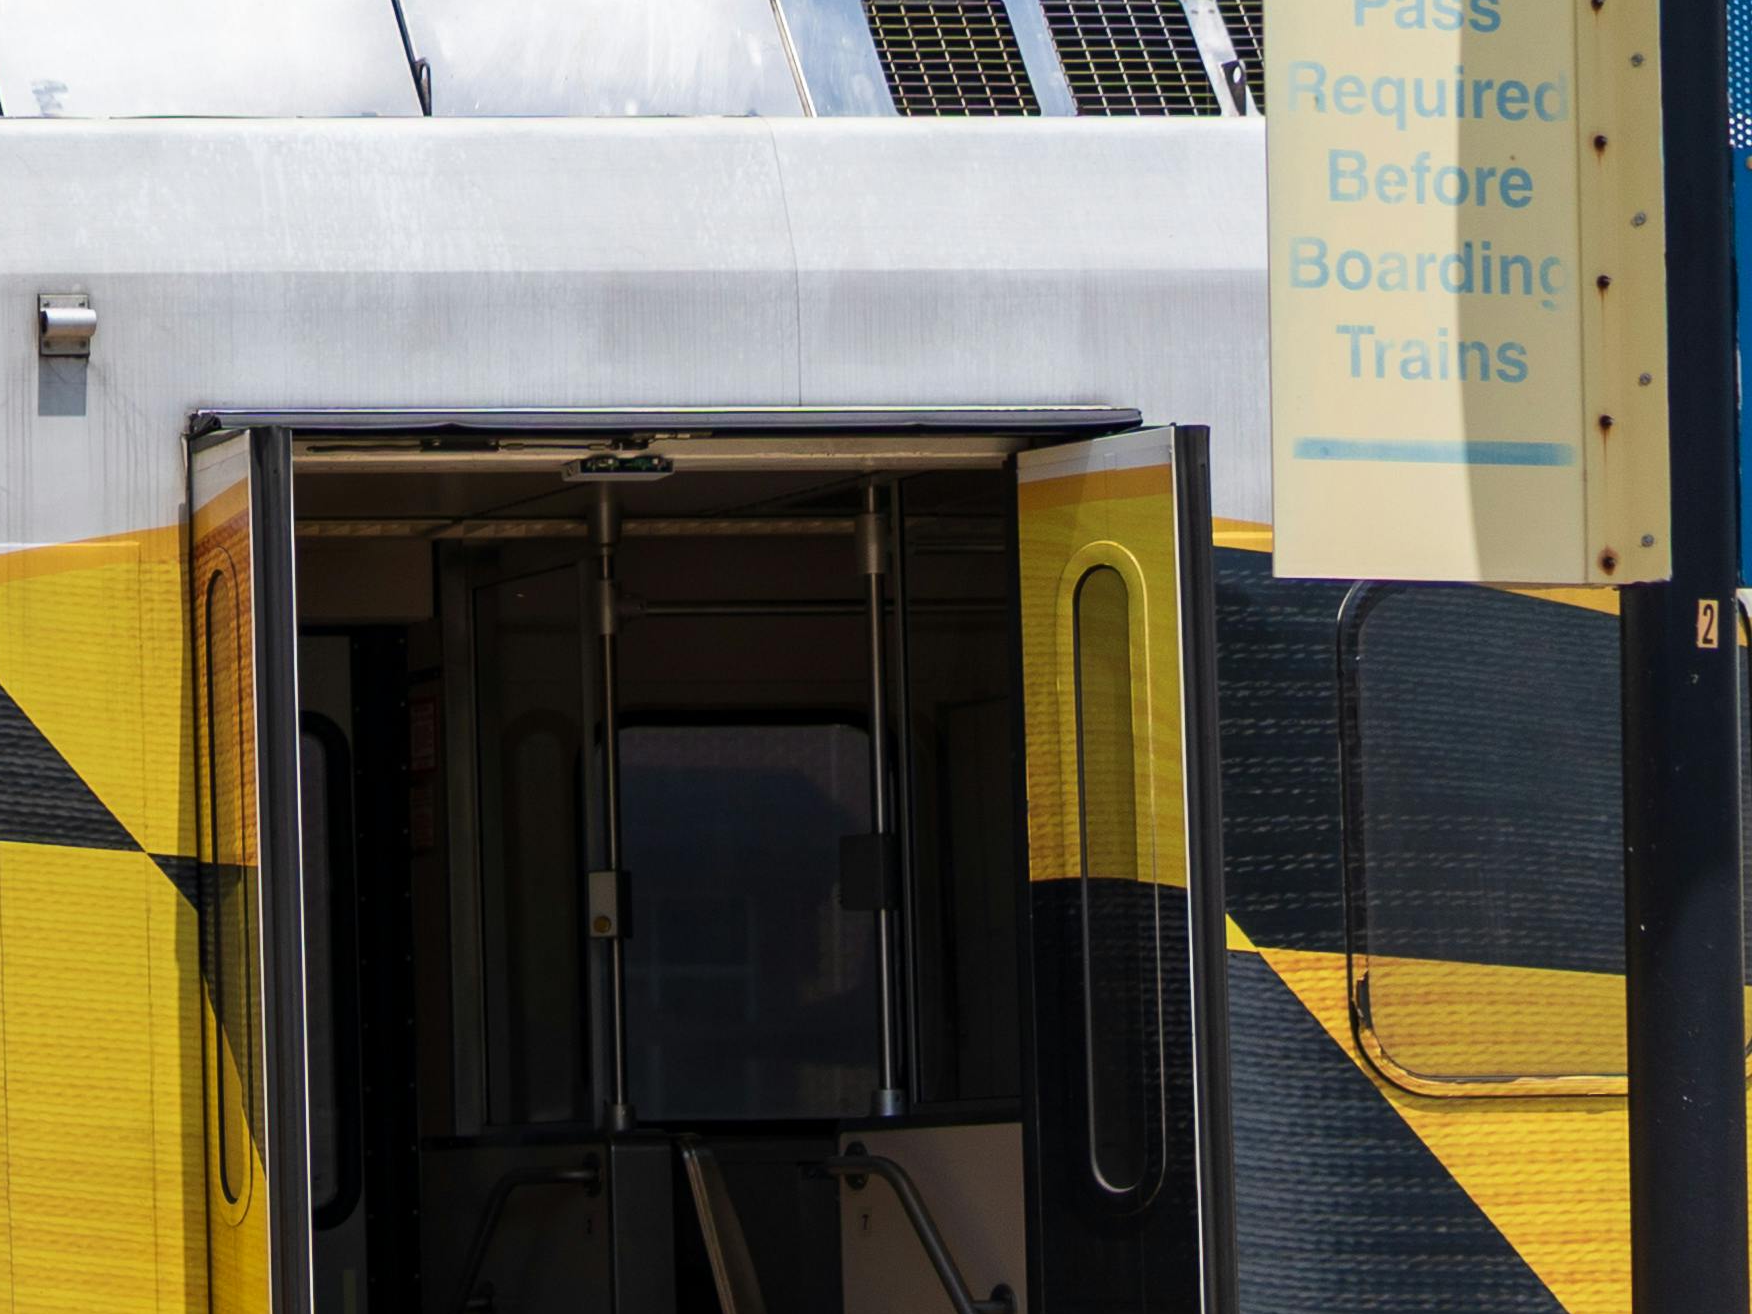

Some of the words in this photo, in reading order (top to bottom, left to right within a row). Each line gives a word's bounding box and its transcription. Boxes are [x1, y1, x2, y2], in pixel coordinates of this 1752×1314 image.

[1287, 60, 1569, 131] Required
[1327, 148, 1533, 209] Before
[1336, 324, 1529, 384] Trains
[1702, 603, 1714, 644] 2
